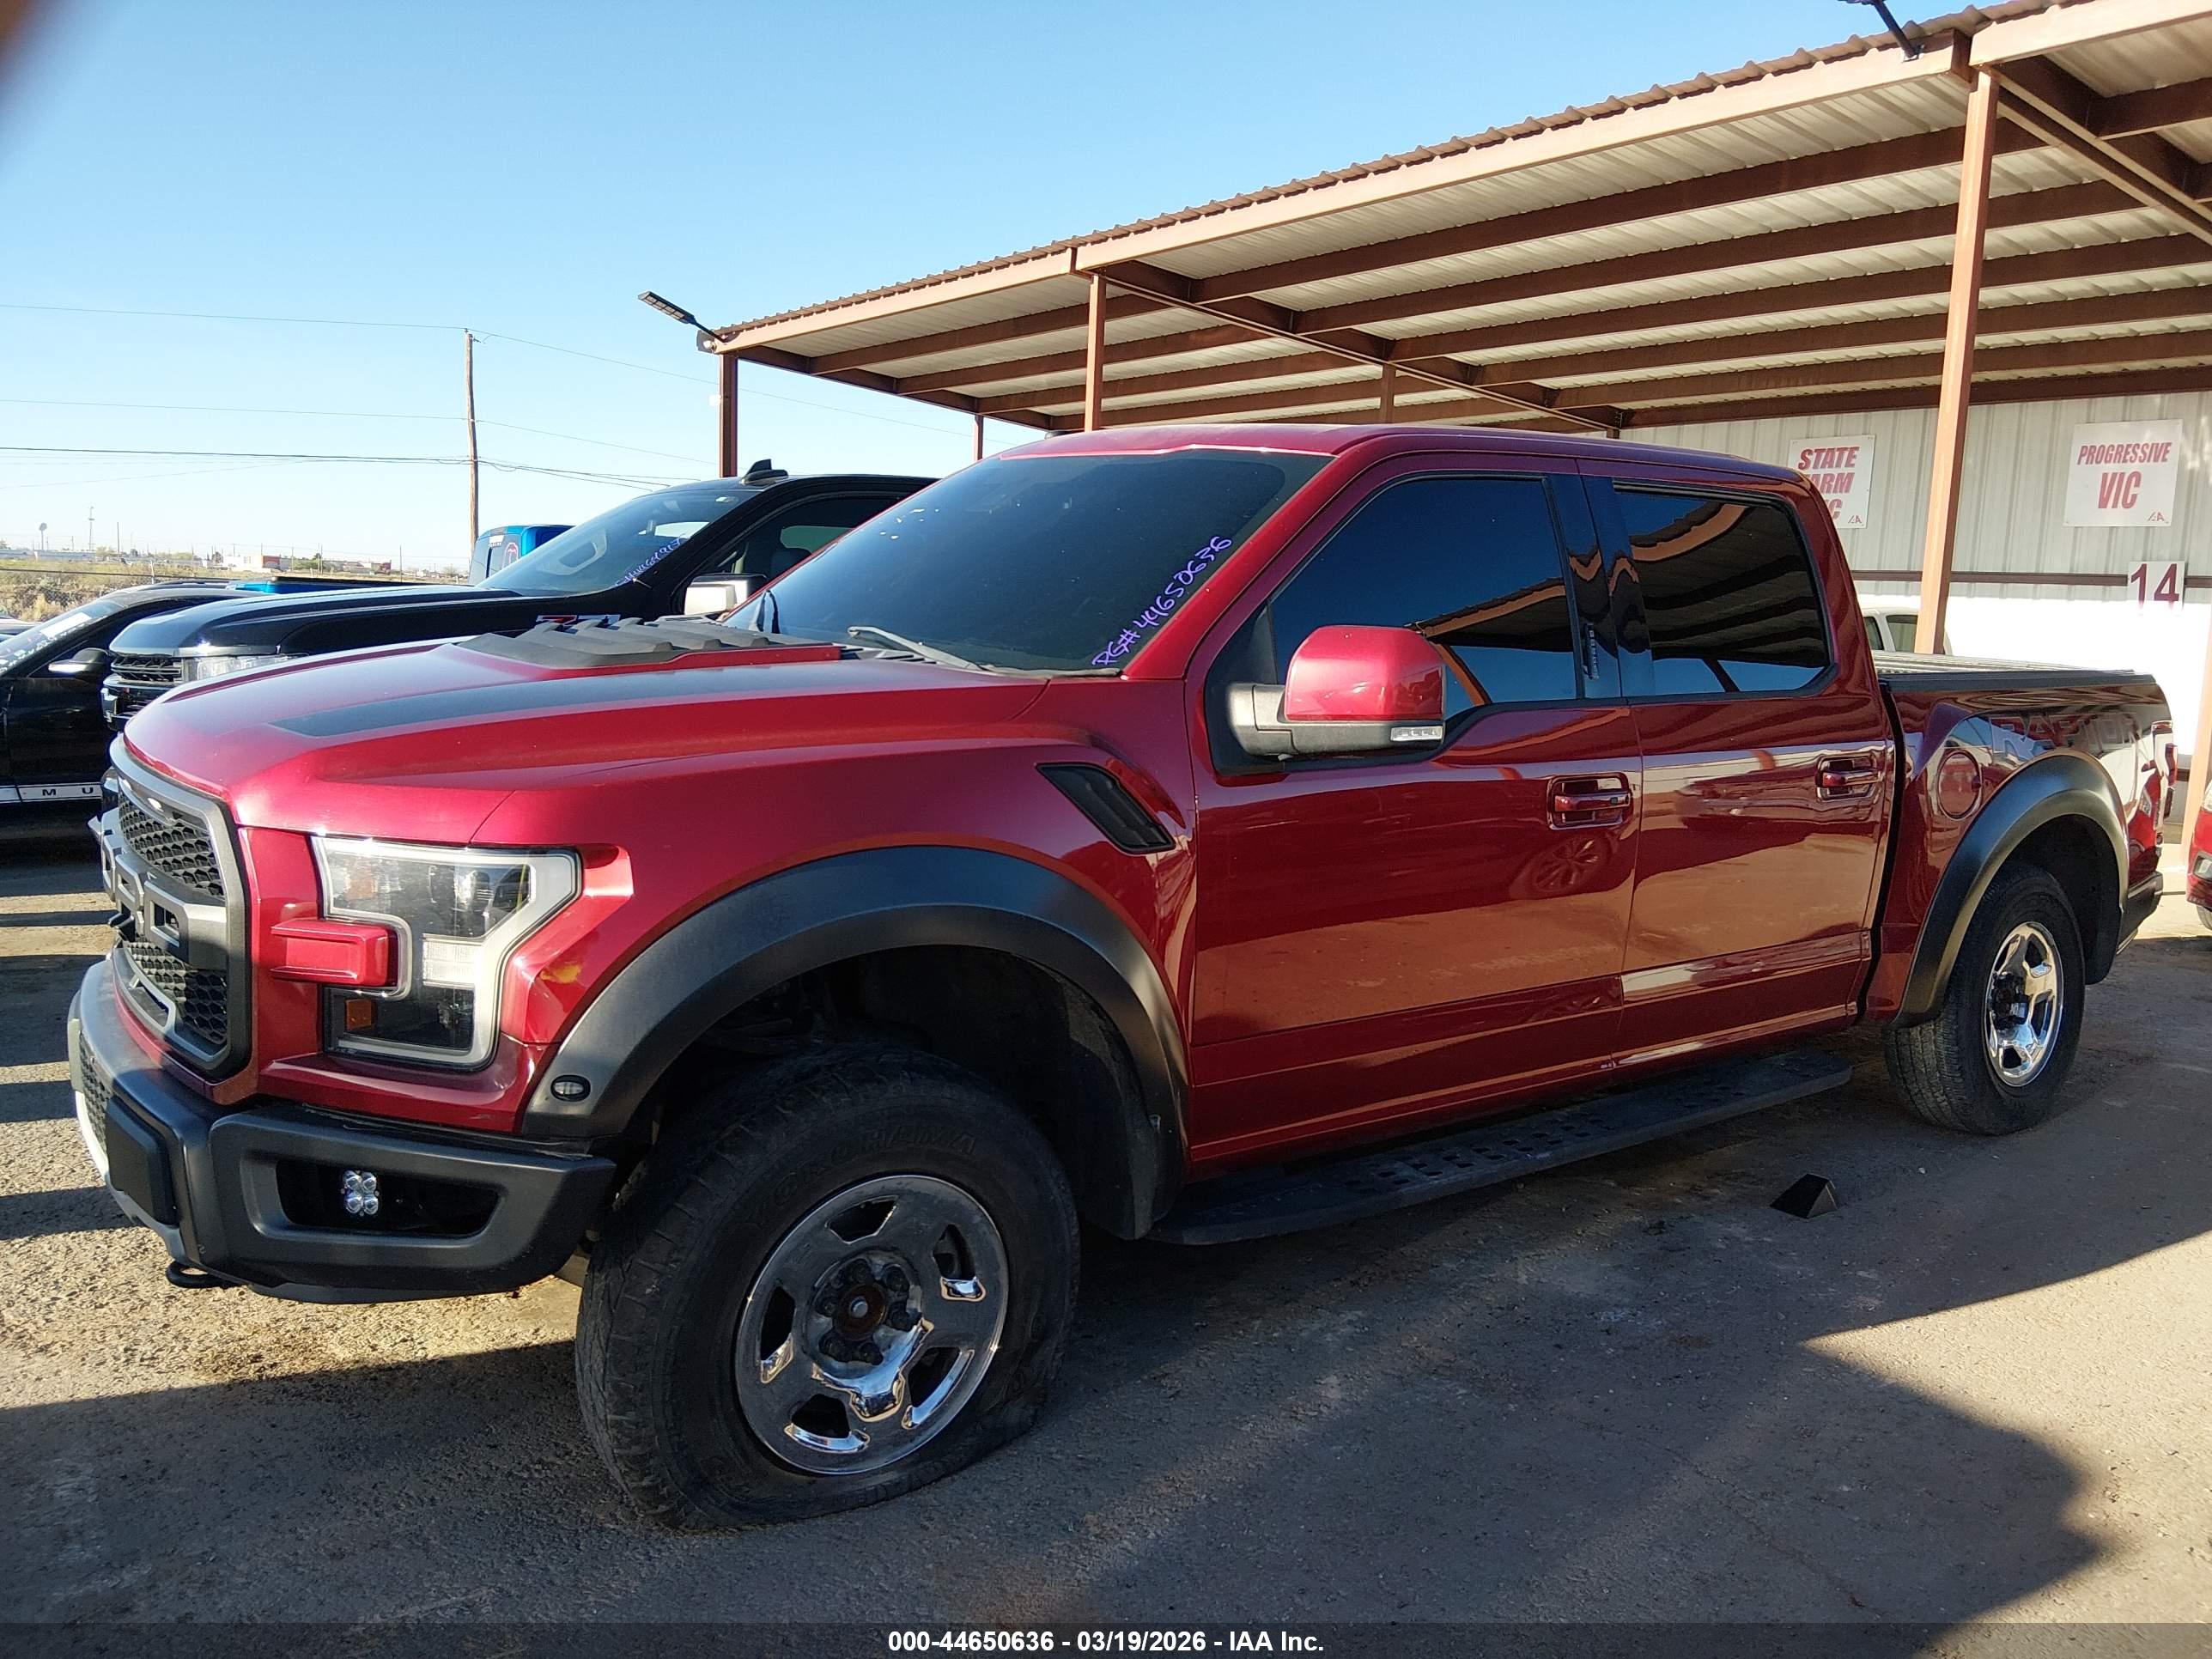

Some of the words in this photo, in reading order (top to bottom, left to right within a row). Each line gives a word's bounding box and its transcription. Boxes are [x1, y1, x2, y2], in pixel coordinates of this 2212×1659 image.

[1797, 446, 1860, 471] STATE
[2077, 441, 2172, 465] PROGRESSIVE
[2097, 471, 2142, 509] VIC
[2130, 563, 2180, 609] 14
